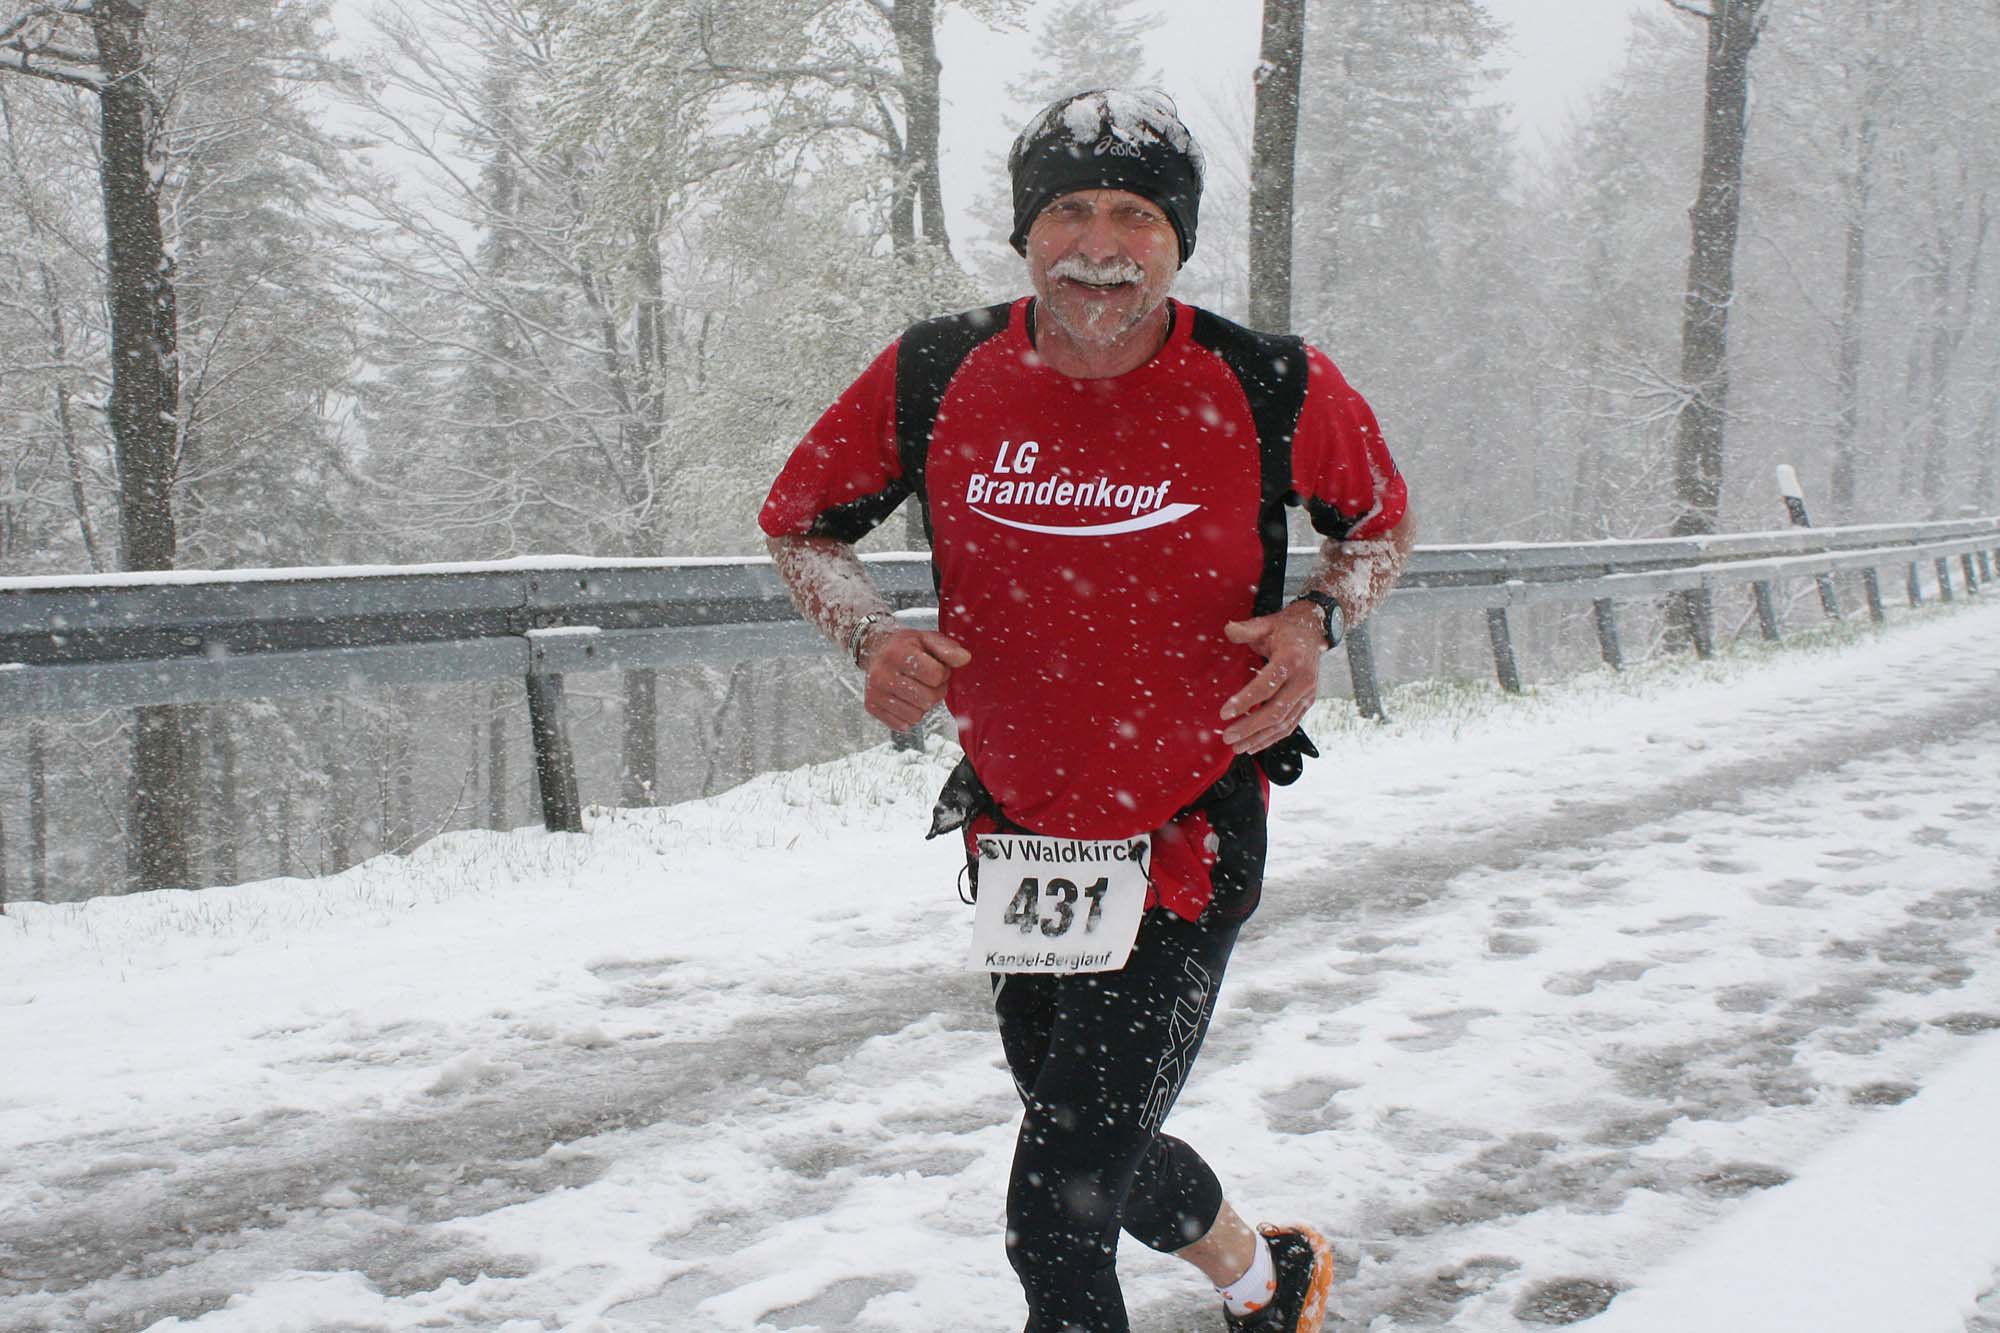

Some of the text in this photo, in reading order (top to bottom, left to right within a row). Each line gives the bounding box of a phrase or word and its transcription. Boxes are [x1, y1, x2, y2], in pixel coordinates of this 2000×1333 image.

[993, 440, 1039, 474] LG
[966, 474, 1172, 516] Brandenkopf
[1004, 877, 1109, 938] 431
